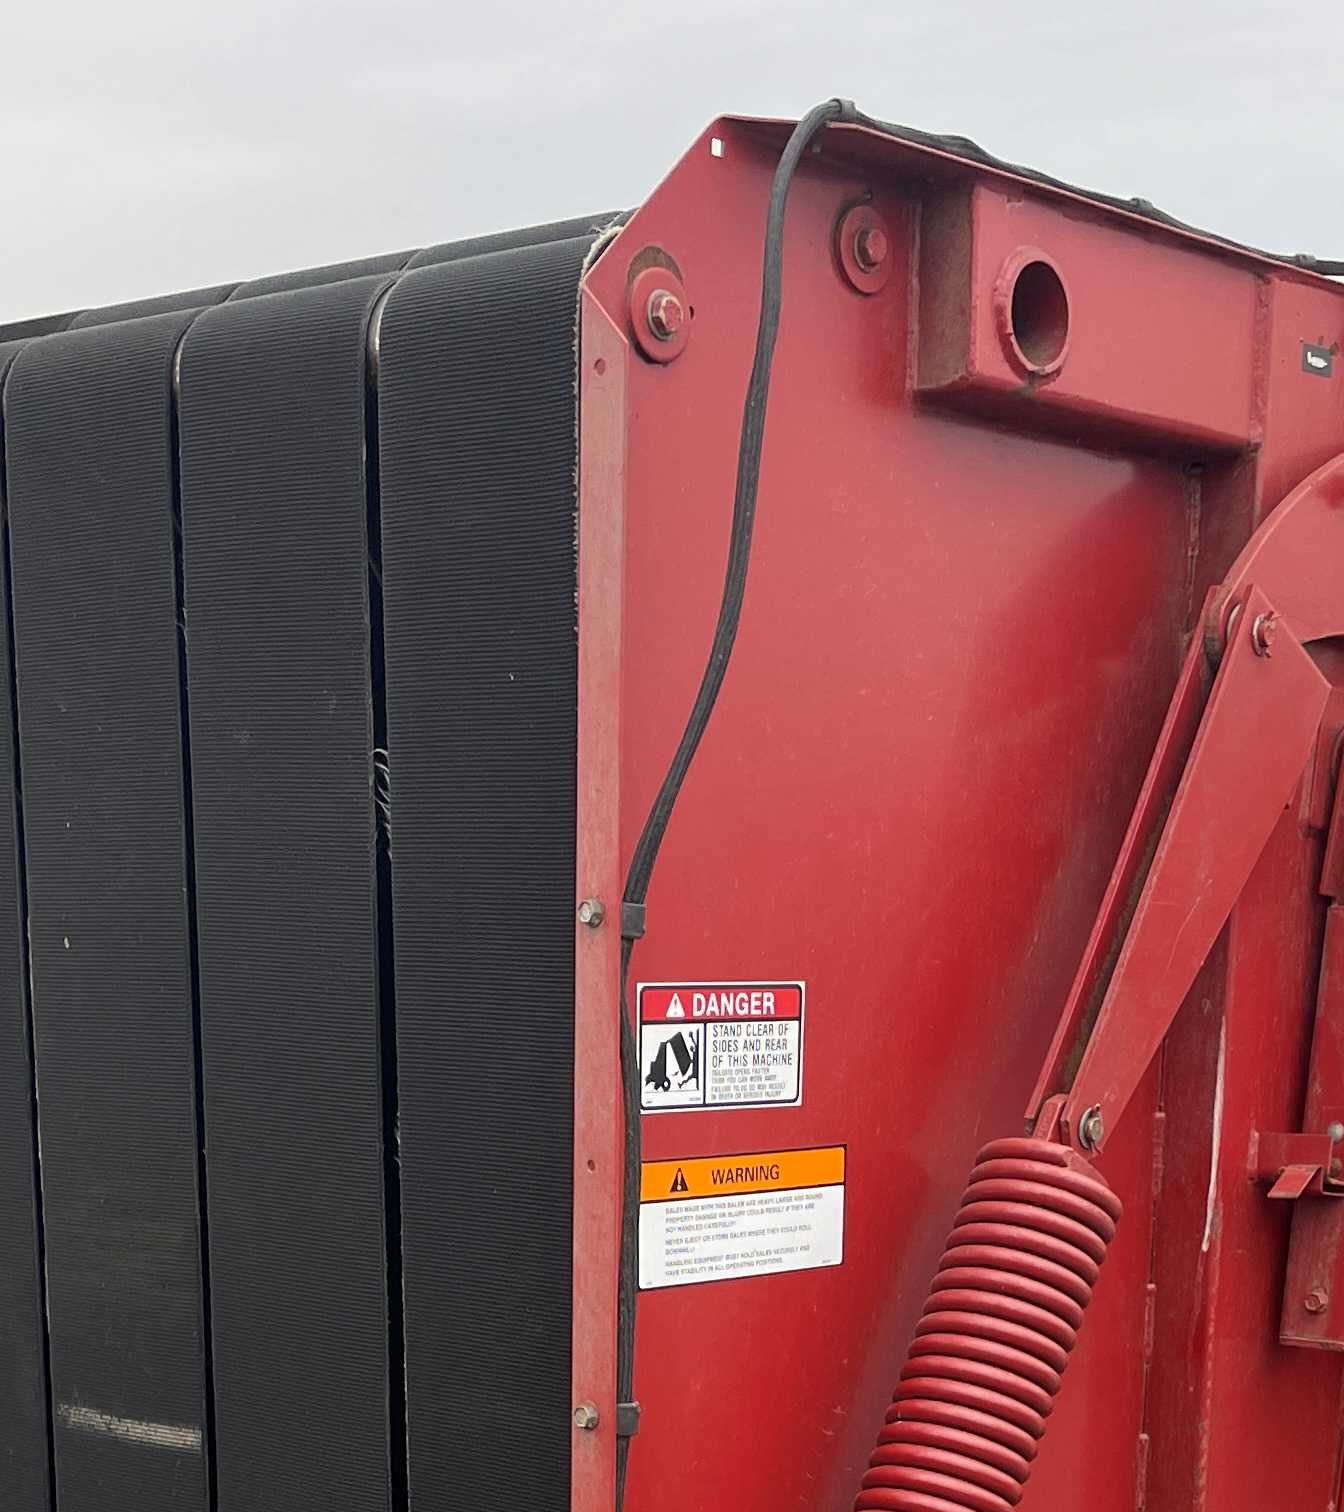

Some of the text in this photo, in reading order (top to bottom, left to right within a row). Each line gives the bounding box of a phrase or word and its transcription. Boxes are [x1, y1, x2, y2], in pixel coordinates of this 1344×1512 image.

[692, 991, 775, 1017] DANGER
[712, 1023, 789, 1037] STAND CLEAR OF
[712, 1038, 787, 1053] SIDES AND REAR
[712, 1053, 792, 1068] OF THIS MACHINE
[711, 1164, 780, 1185] WARNING
